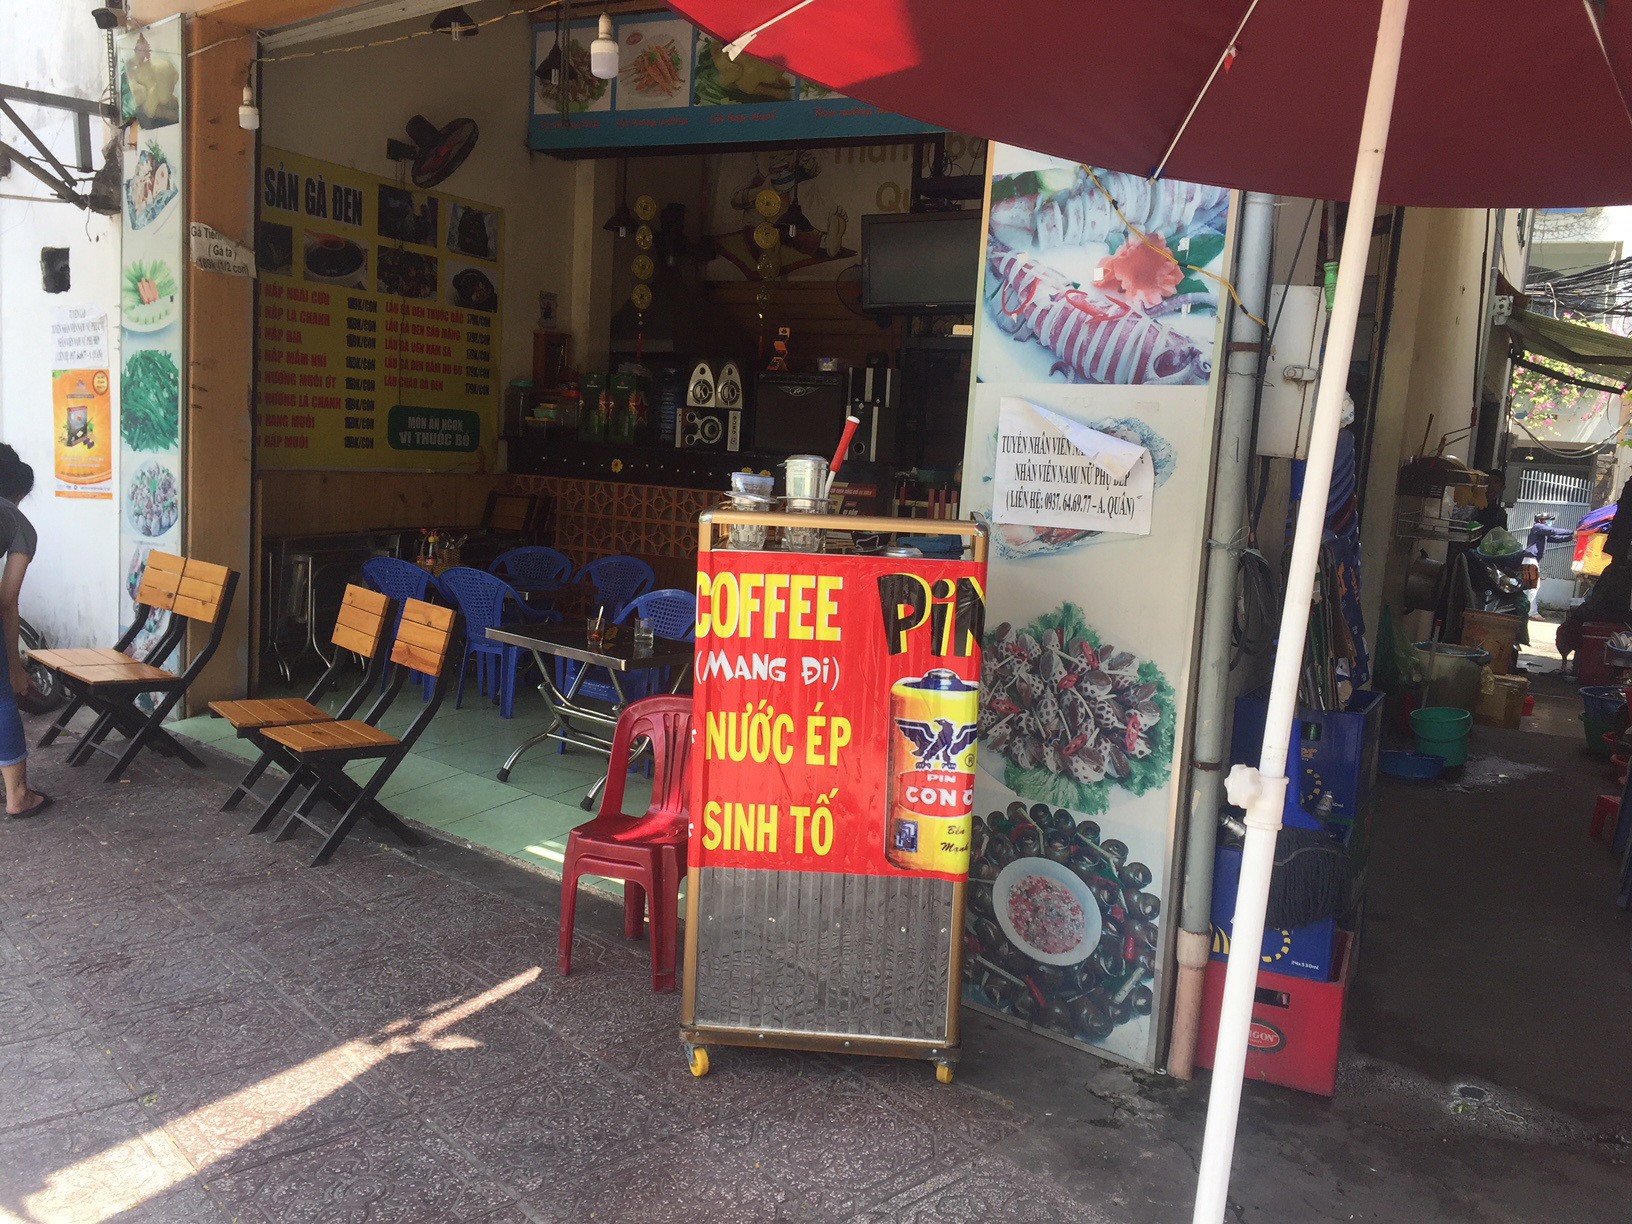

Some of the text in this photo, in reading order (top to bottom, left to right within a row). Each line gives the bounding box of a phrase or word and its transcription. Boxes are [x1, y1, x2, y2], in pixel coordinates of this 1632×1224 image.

[305, 175, 328, 219] GÀ
[1028, 431, 1052, 456] NHÂN
[1014, 459, 1038, 482] NHÂN
[1038, 459, 1057, 482] VIÊN
[695, 571, 843, 642] COFFEE
[706, 699, 852, 766] NƯỚC ÉP
[906, 786, 956, 806] CON
[926, 774, 956, 784] PIN
[702, 788, 839, 856] SINH TỐ
